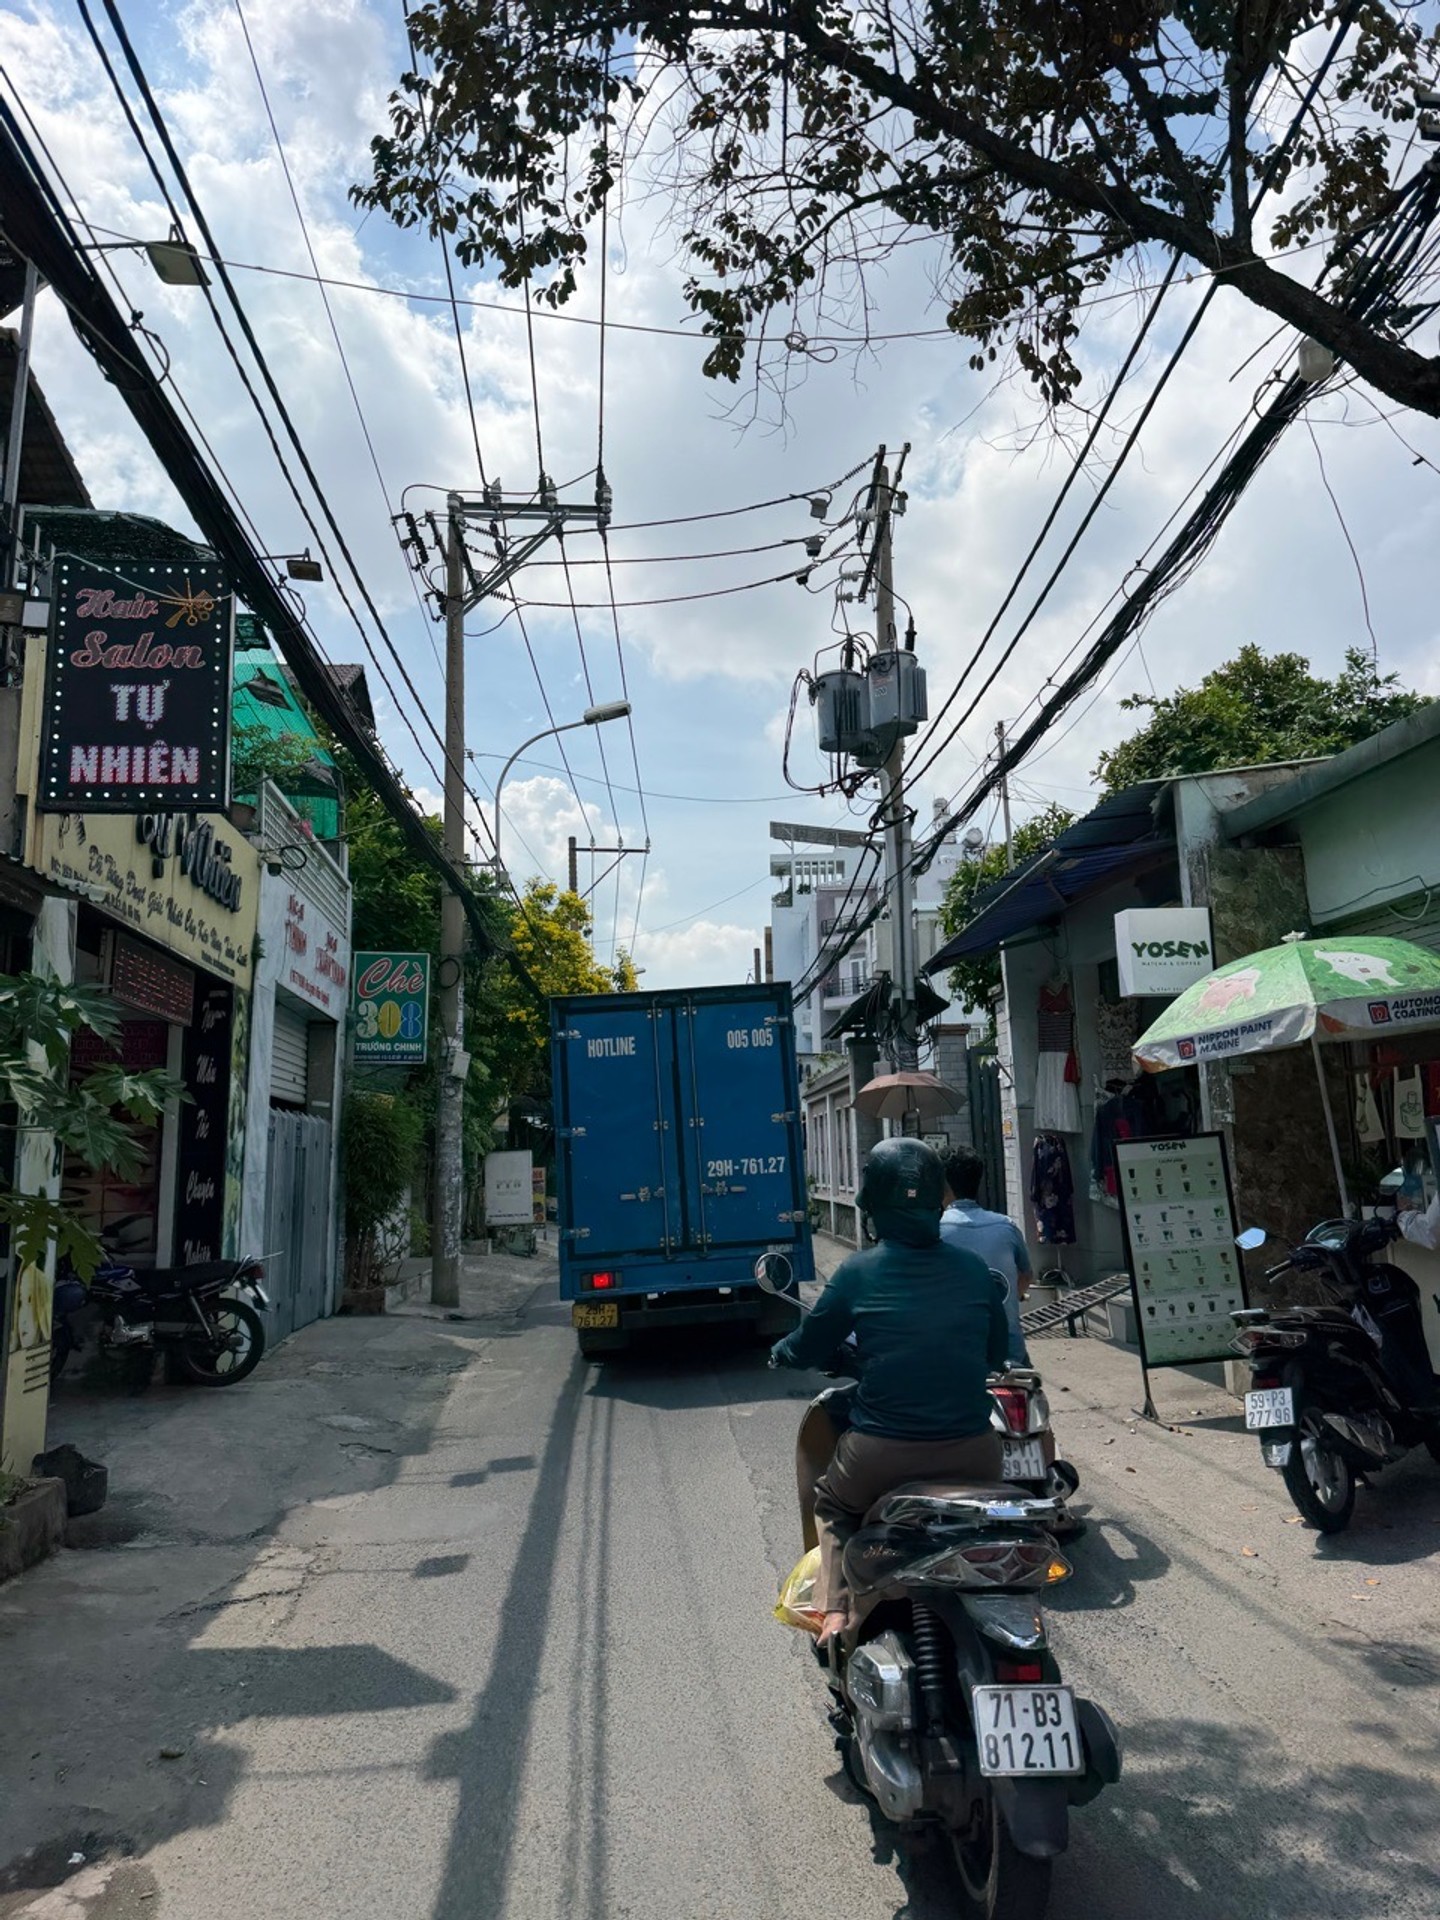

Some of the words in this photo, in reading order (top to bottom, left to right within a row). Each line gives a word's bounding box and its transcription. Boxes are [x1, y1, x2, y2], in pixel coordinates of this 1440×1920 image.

[76, 588, 159, 619] Hair
[70, 630, 206, 669] Salon
[110, 680, 171, 730] TỰ
[70, 740, 200, 784] NHIÊN
[1131, 940, 1209, 959] YOSEN
[357, 957, 425, 999] Chè
[356, 1000, 423, 1039] 308
[727, 1030, 749, 1048] 005
[751, 1028, 774, 1047] 005
[1198, 1027, 1239, 1045] NIPPON
[1240, 1020, 1273, 1035] PAINT
[393, 1042, 422, 1052] CHINH
[587, 1036, 636, 1058] HOTLINE
[1200, 1038, 1240, 1054] MARINE
[1150, 1141, 1187, 1151] YOSEN
[1251, 1391, 1286, 1409] 59-P3
[1249, 1409, 1292, 1427] 277.96
[989, 1692, 1062, 1728] 71-B3
[985, 1732, 1074, 1769] 812.11
